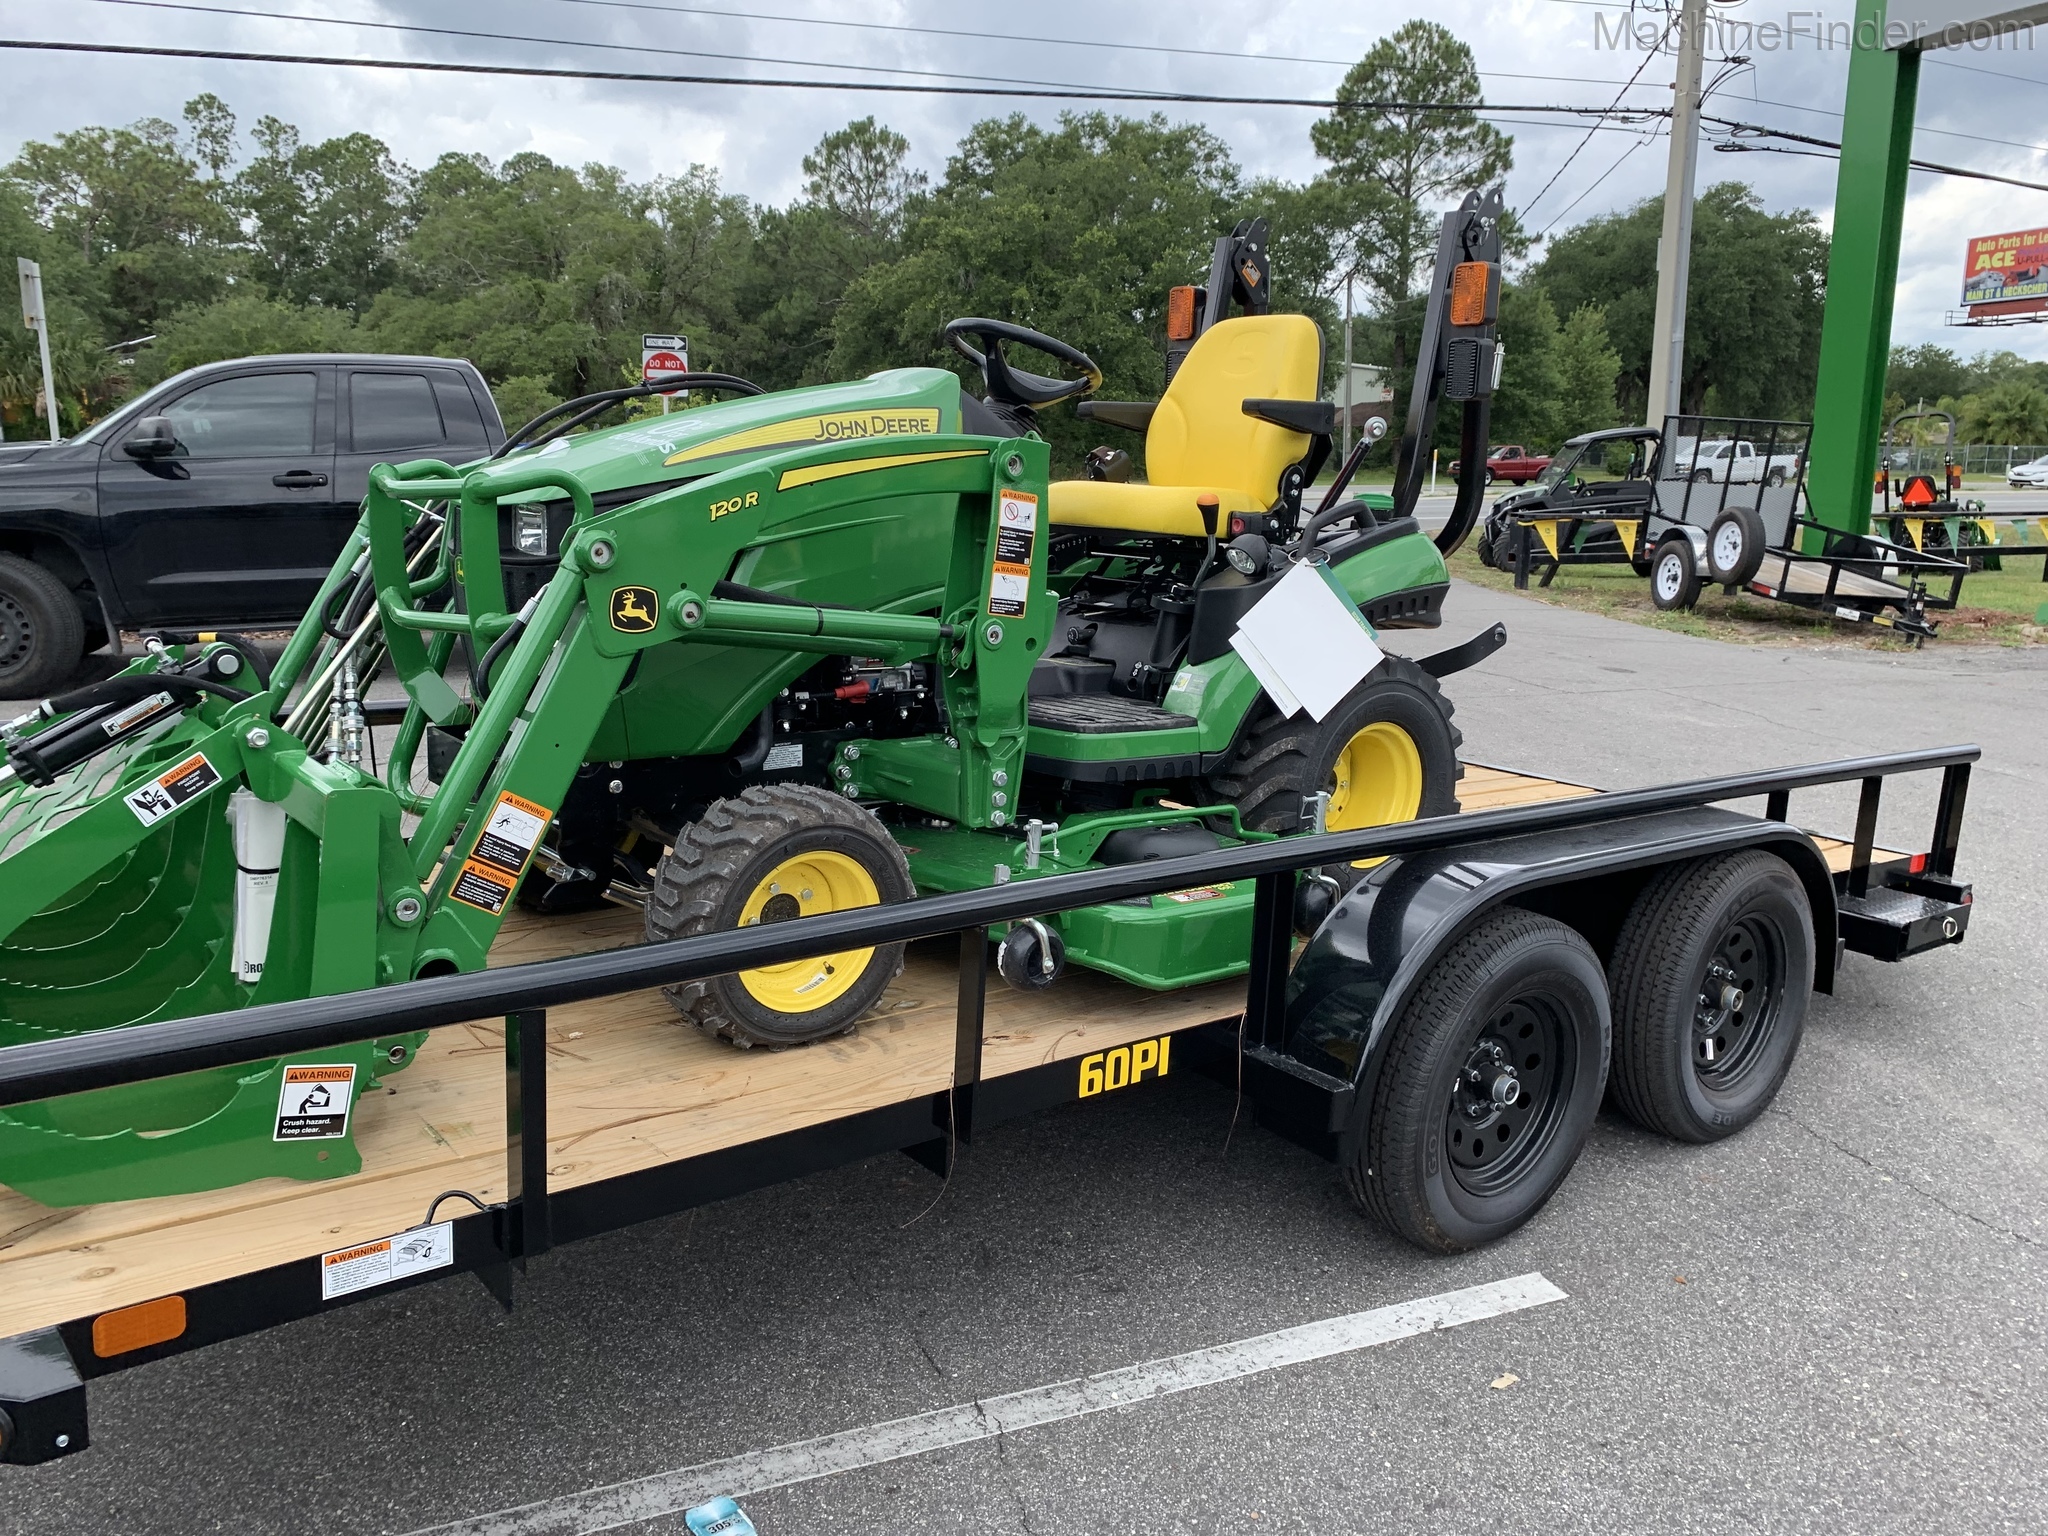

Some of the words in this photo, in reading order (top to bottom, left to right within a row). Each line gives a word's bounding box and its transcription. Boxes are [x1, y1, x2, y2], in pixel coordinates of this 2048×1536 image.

[1976, 240, 1996, 253] Auto
[1998, 235, 2021, 249] Parts
[2023, 233, 2037, 246] for
[1974, 249, 2017, 271] ACE
[1965, 289, 1984, 301] MAIN
[1985, 288, 1995, 299] ST
[2002, 282, 2048, 297] HECKSCHER
[649, 359, 660, 368] DO
[664, 360, 681, 369] NOT
[815, 418, 869, 439] JOHN
[871, 415, 932, 435] DEERE
[1007, 491, 1036, 503] WARNING
[1000, 565, 1029, 576] WARNING
[169, 757, 202, 781] WARNING
[514, 798, 546, 818] WARNING
[478, 867, 511, 885] WARNING
[299, 1070, 350, 1080] WARNING
[1078, 1035, 1172, 1099] 60PI
[282, 1119, 305, 1127] Crush
[305, 1118, 332, 1126] hazard.
[338, 1243, 384, 1261] WARNING
